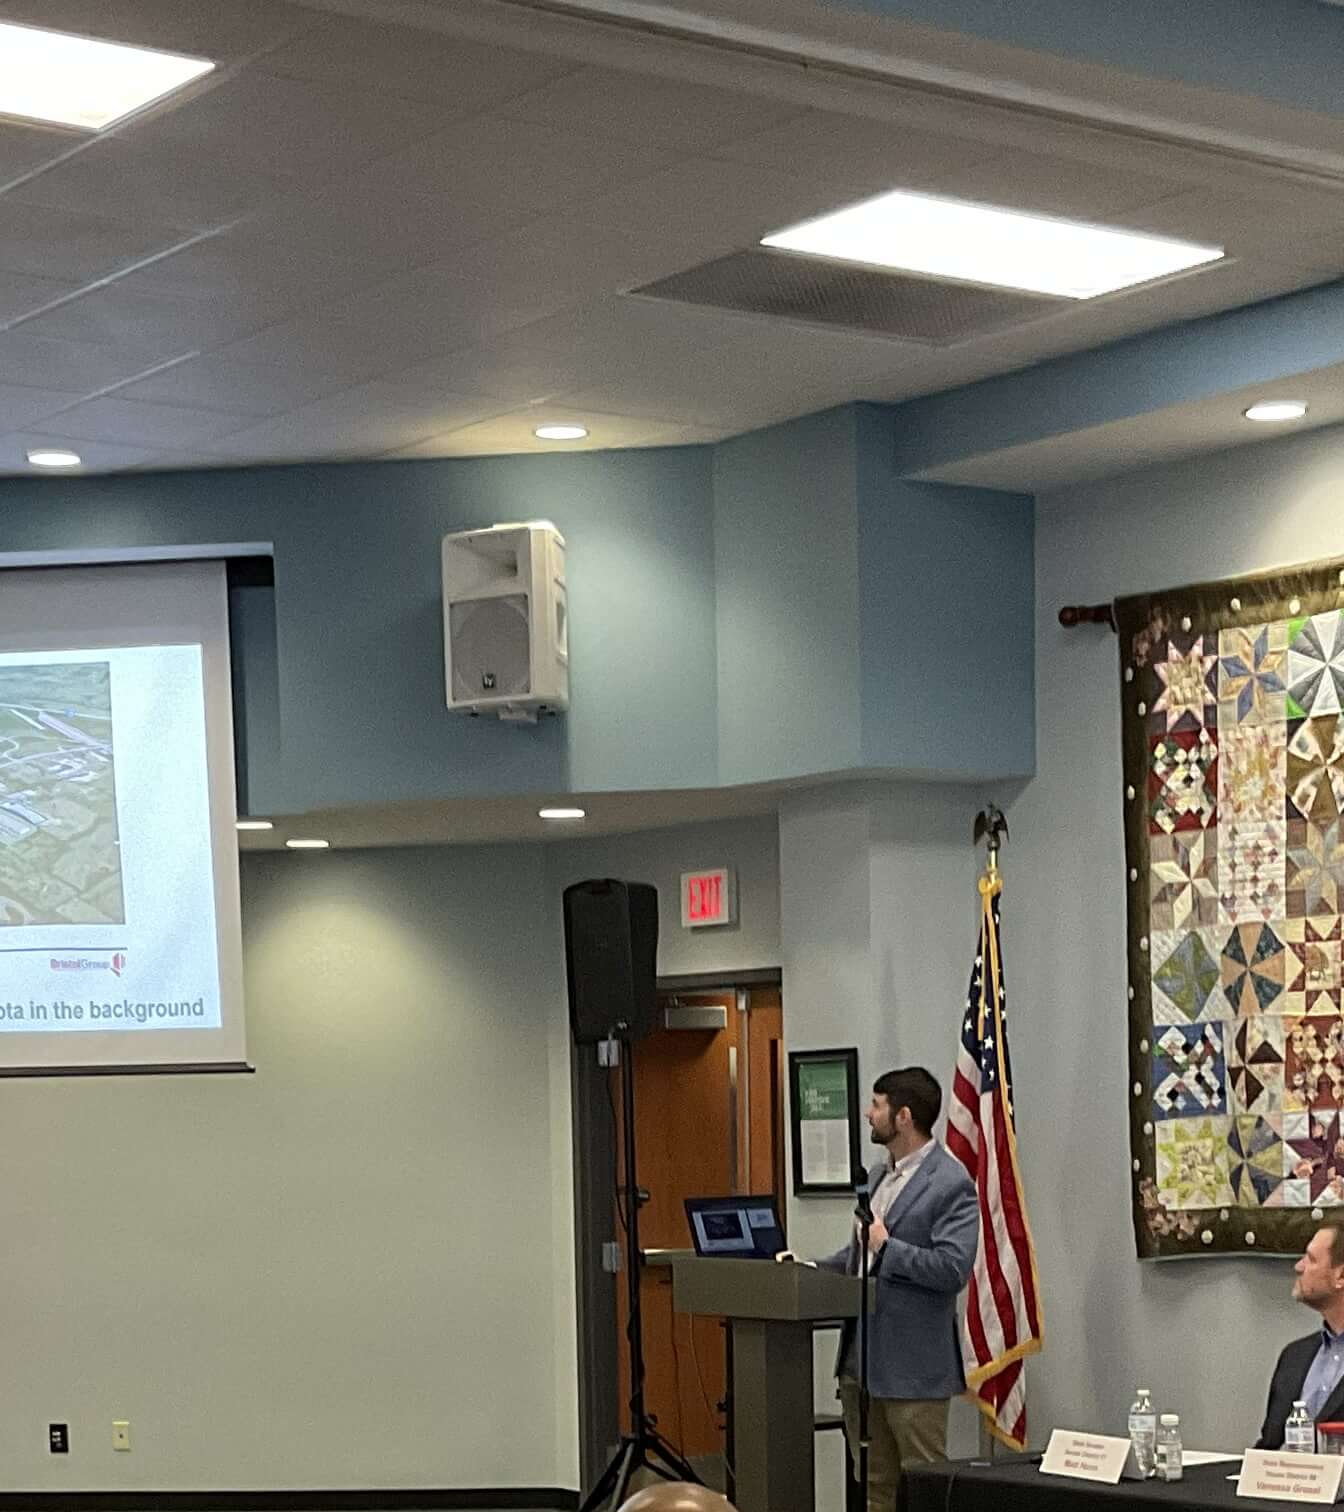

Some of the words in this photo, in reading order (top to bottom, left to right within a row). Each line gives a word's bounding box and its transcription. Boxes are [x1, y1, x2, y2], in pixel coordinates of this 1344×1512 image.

[688, 876, 721, 921] EXIT
[29, 1000, 48, 1019] in
[54, 1000, 84, 1019] the
[89, 998, 204, 1021] background
